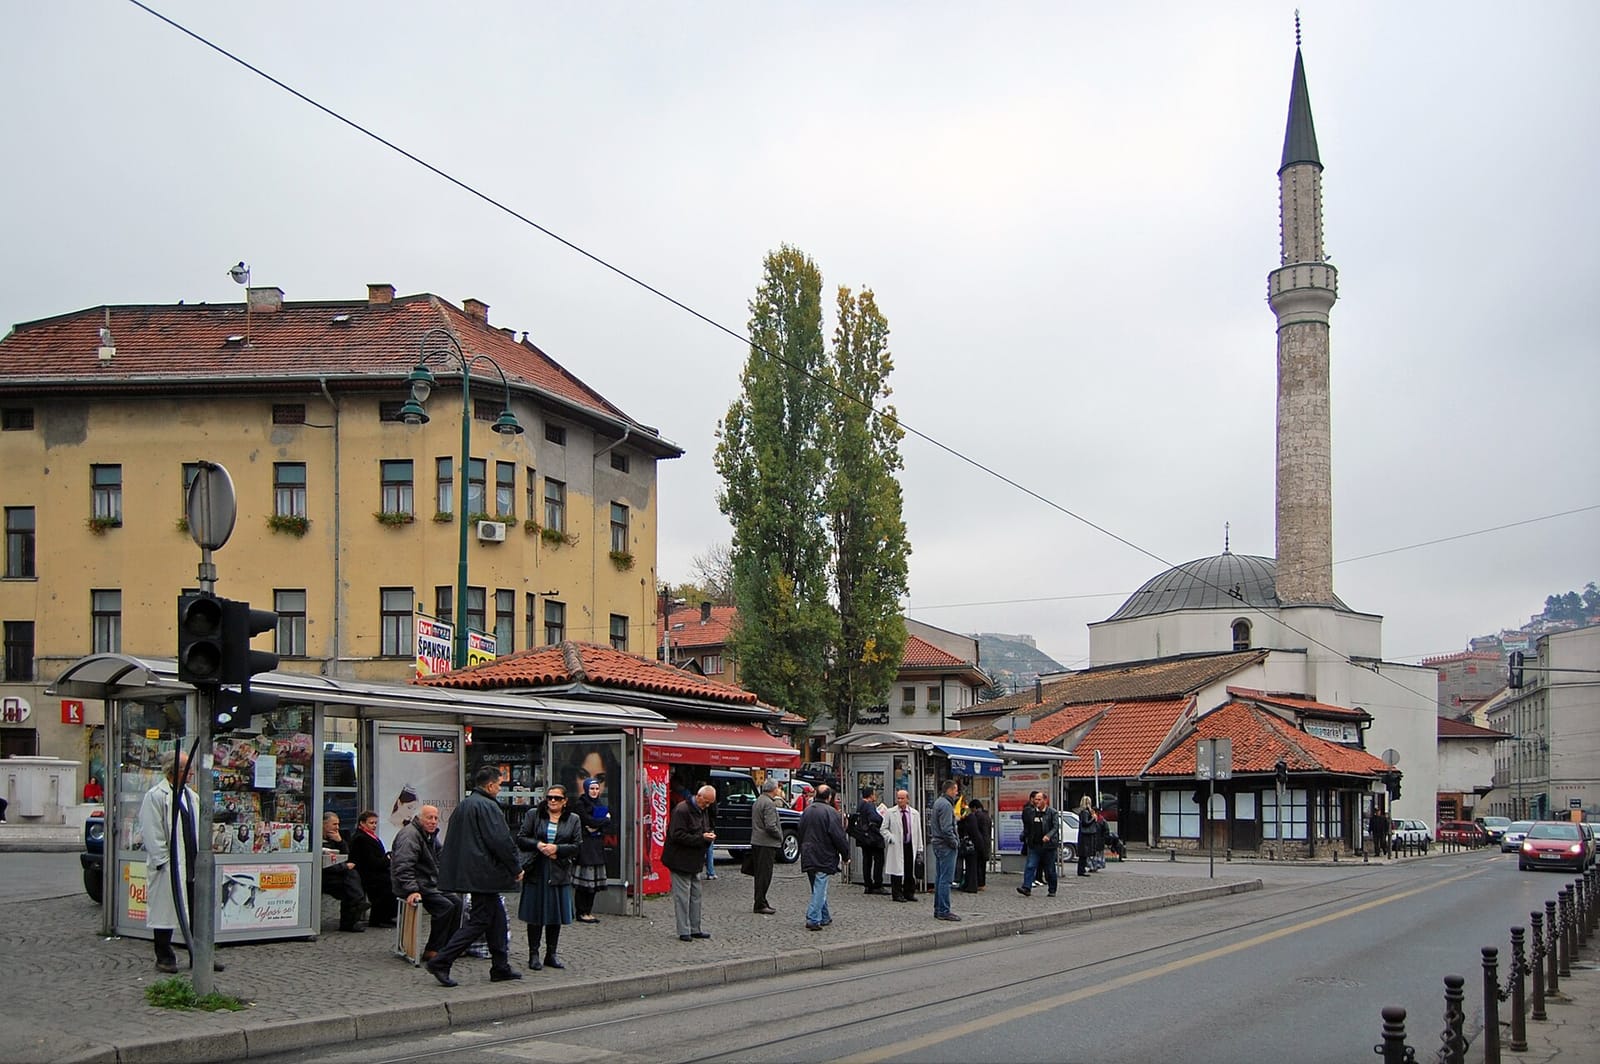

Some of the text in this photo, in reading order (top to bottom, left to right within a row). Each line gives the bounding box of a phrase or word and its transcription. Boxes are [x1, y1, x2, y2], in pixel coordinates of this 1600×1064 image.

[420, 622, 431, 635] tv1
[418, 636, 450, 661] ŠPANSKA
[432, 657, 450, 674] LIGA
[400, 737, 453, 751] tv1 mreža
[130, 884, 147, 903] Ogl
